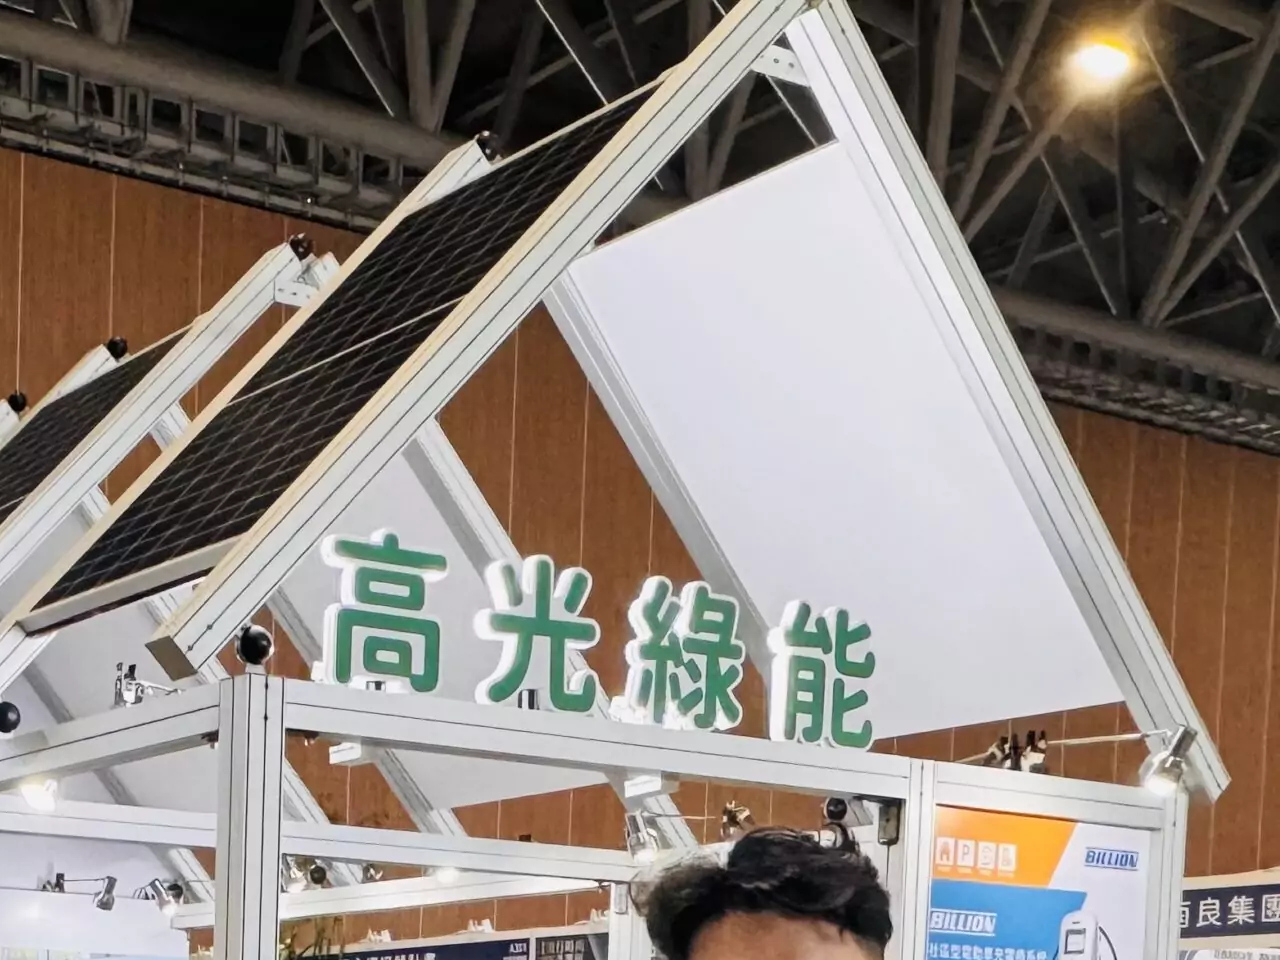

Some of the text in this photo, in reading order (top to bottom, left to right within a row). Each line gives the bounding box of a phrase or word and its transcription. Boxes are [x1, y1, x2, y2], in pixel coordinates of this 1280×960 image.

[325, 531, 877, 749] 高光綠能
[1084, 849, 1138, 868] BILLION
[928, 911, 996, 933] BILLION
